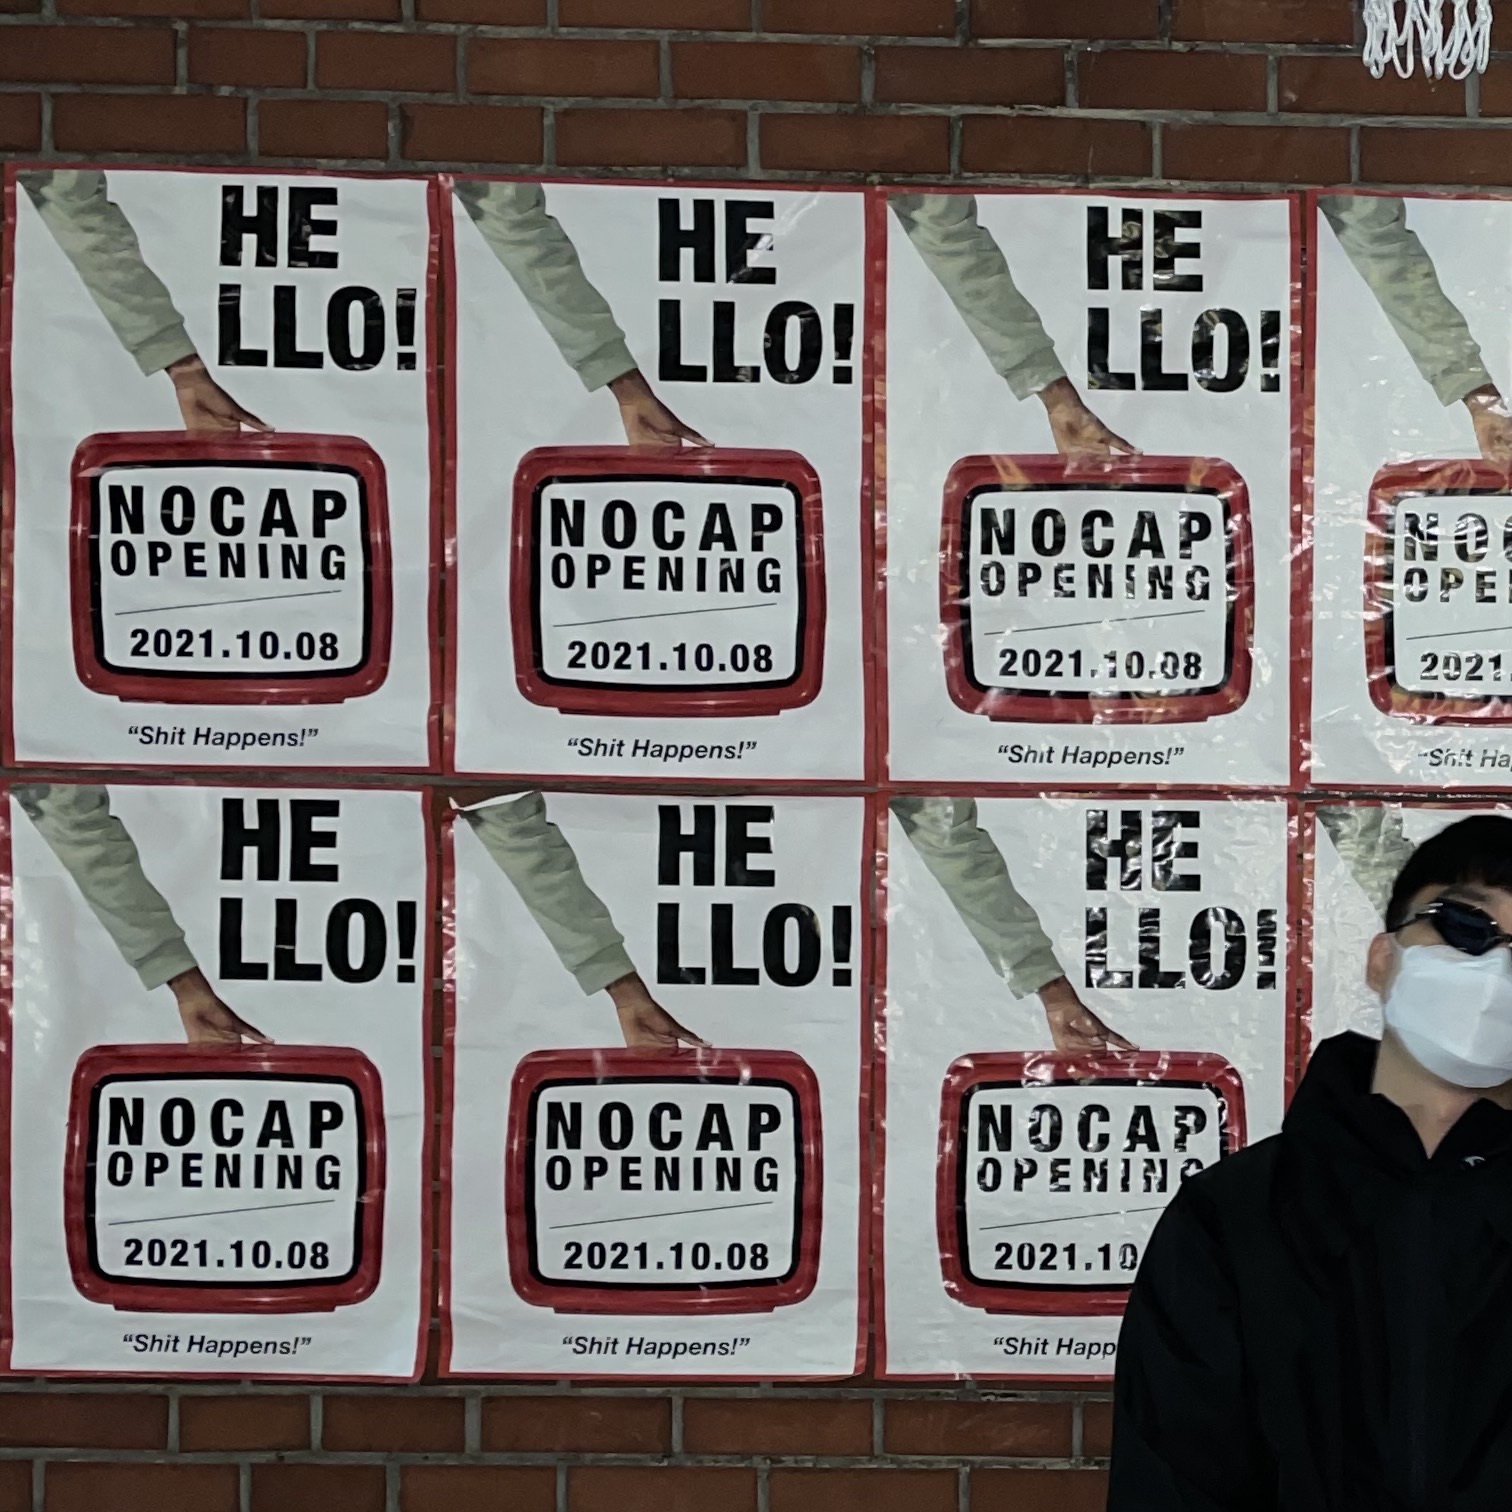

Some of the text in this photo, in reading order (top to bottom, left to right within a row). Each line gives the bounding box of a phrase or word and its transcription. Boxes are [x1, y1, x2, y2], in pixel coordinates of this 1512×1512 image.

[220, 185, 338, 268] HE
[659, 198, 776, 284] HE
[1087, 206, 1203, 292] HE
[218, 284, 416, 371] LLO!
[659, 299, 854, 384] LLO!
[1088, 308, 1280, 392] LLO!
[109, 485, 346, 538] NOCAP
[551, 499, 782, 551] NOCAP
[981, 508, 1211, 559] NOCAP
[111, 540, 345, 580] OPENING
[552, 553, 780, 593] OPENING
[981, 561, 1209, 600] OPENING
[131, 629, 338, 660] 2021.10.08
[568, 641, 772, 672] 2021.10.08
[1000, 649, 1201, 679] 2021.10.08
[221, 798, 339, 882] HE
[658, 805, 775, 887] HE
[1086, 810, 1200, 891] HE
[220, 898, 416, 983] LLO!
[657, 903, 851, 987] LLO!
[1086, 907, 1277, 990] LLO!
[109, 1098, 343, 1148] NOCAP
[547, 1102, 781, 1151] NOCAP
[978, 1104, 1206, 1152] NOCAP
[108, 1151, 340, 1190] OPENING
[546, 1156, 777, 1192] OPENING
[125, 1239, 328, 1269] 2021.10.08
[565, 1242, 768, 1270] 2021.10.08
[994, 1243, 1138, 1271] 2021.10
